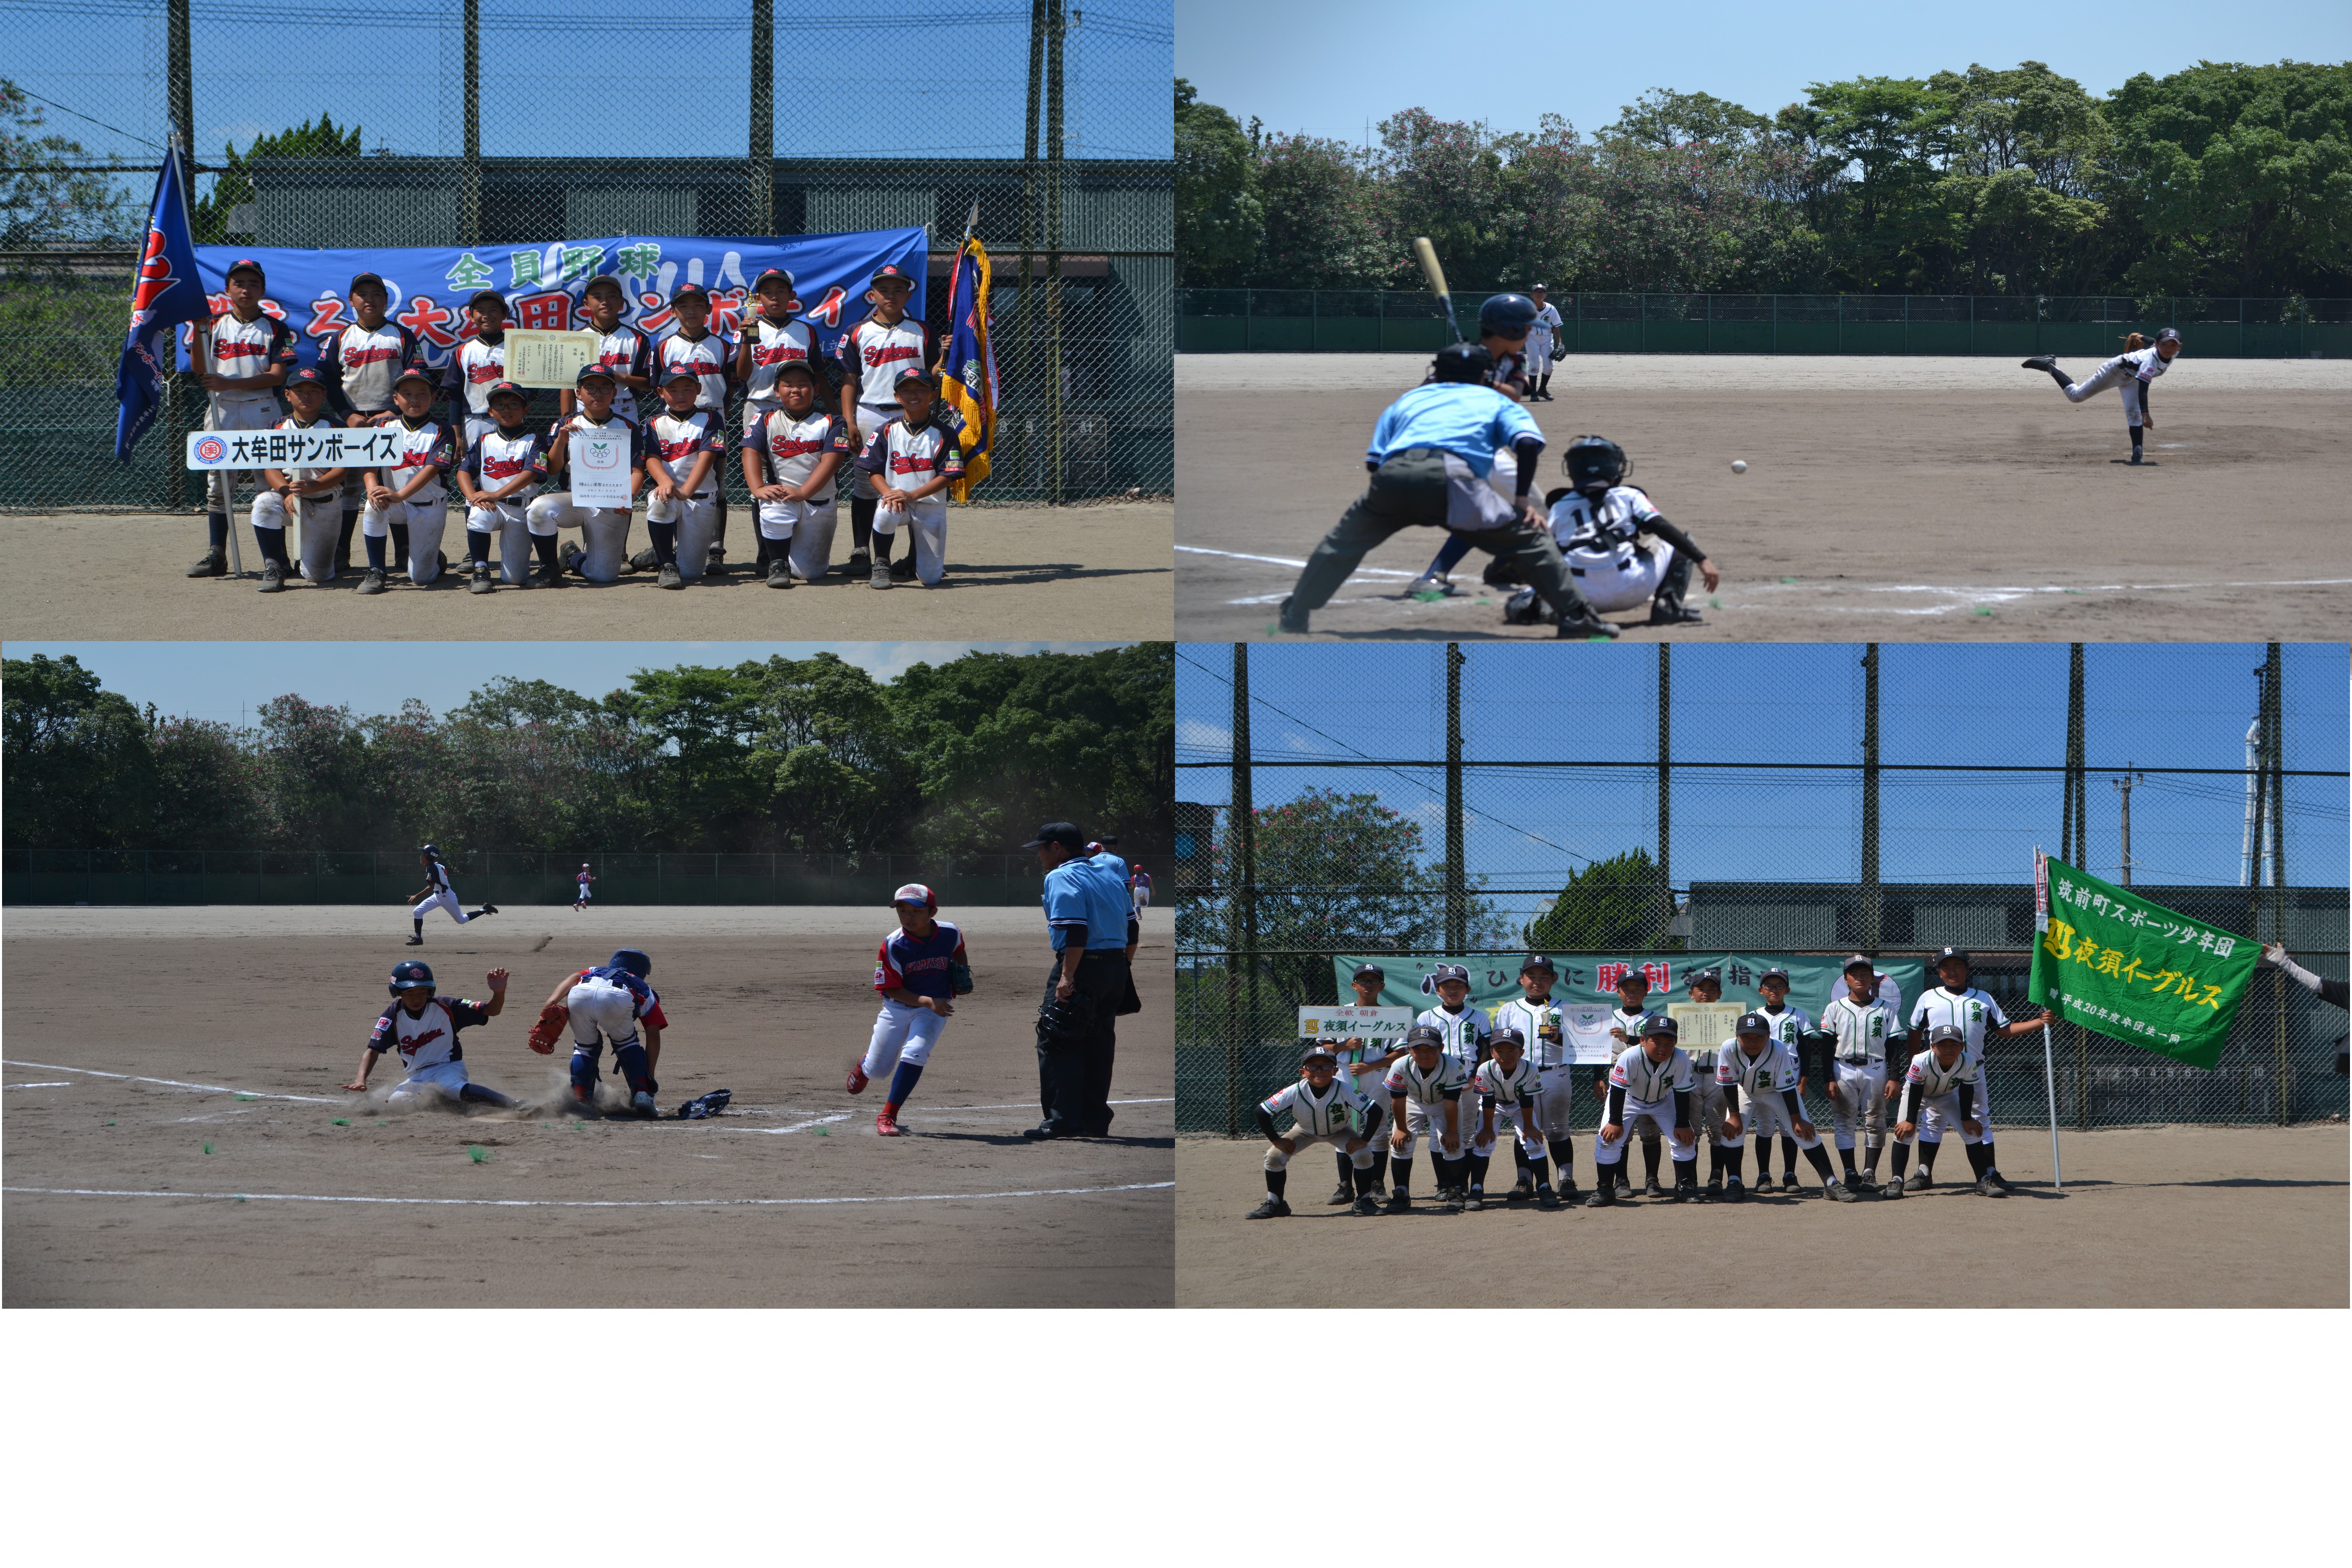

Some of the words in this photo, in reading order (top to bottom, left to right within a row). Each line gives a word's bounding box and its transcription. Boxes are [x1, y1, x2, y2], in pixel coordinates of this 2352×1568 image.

[445, 242, 661, 292] 全員野球
[214, 337, 269, 359] Sunboys
[345, 346, 400, 364] Sunboys
[573, 348, 577, 356] 優勝
[753, 343, 806, 360] Sunboys
[864, 342, 920, 361] Sunboys
[467, 361, 504, 379] Sunbo
[232, 432, 397, 463] 大牟田サンボーイズ
[483, 456, 525, 472] Sunbo
[2057, 877, 2237, 959] 筑前町スポーツ少年団
[2074, 937, 2222, 1010] 夜須イーグルス
[1971, 1001, 1982, 1023] 夜須
[2061, 993, 2180, 1045] 平成20年度卒団生一同
[1323, 1020, 1407, 1033] 夜須イーグルス
[1463, 1021, 1475, 1045] 夜須
[1783, 1021, 1796, 1044] 夜須
[1870, 1016, 1883, 1039] 夜須
[1369, 1038, 1383, 1049] 須
[1455, 1073, 1467, 1083] 福岡
[1758, 1070, 1771, 1089] 夜須
[1330, 1102, 1345, 1125] 夜須
